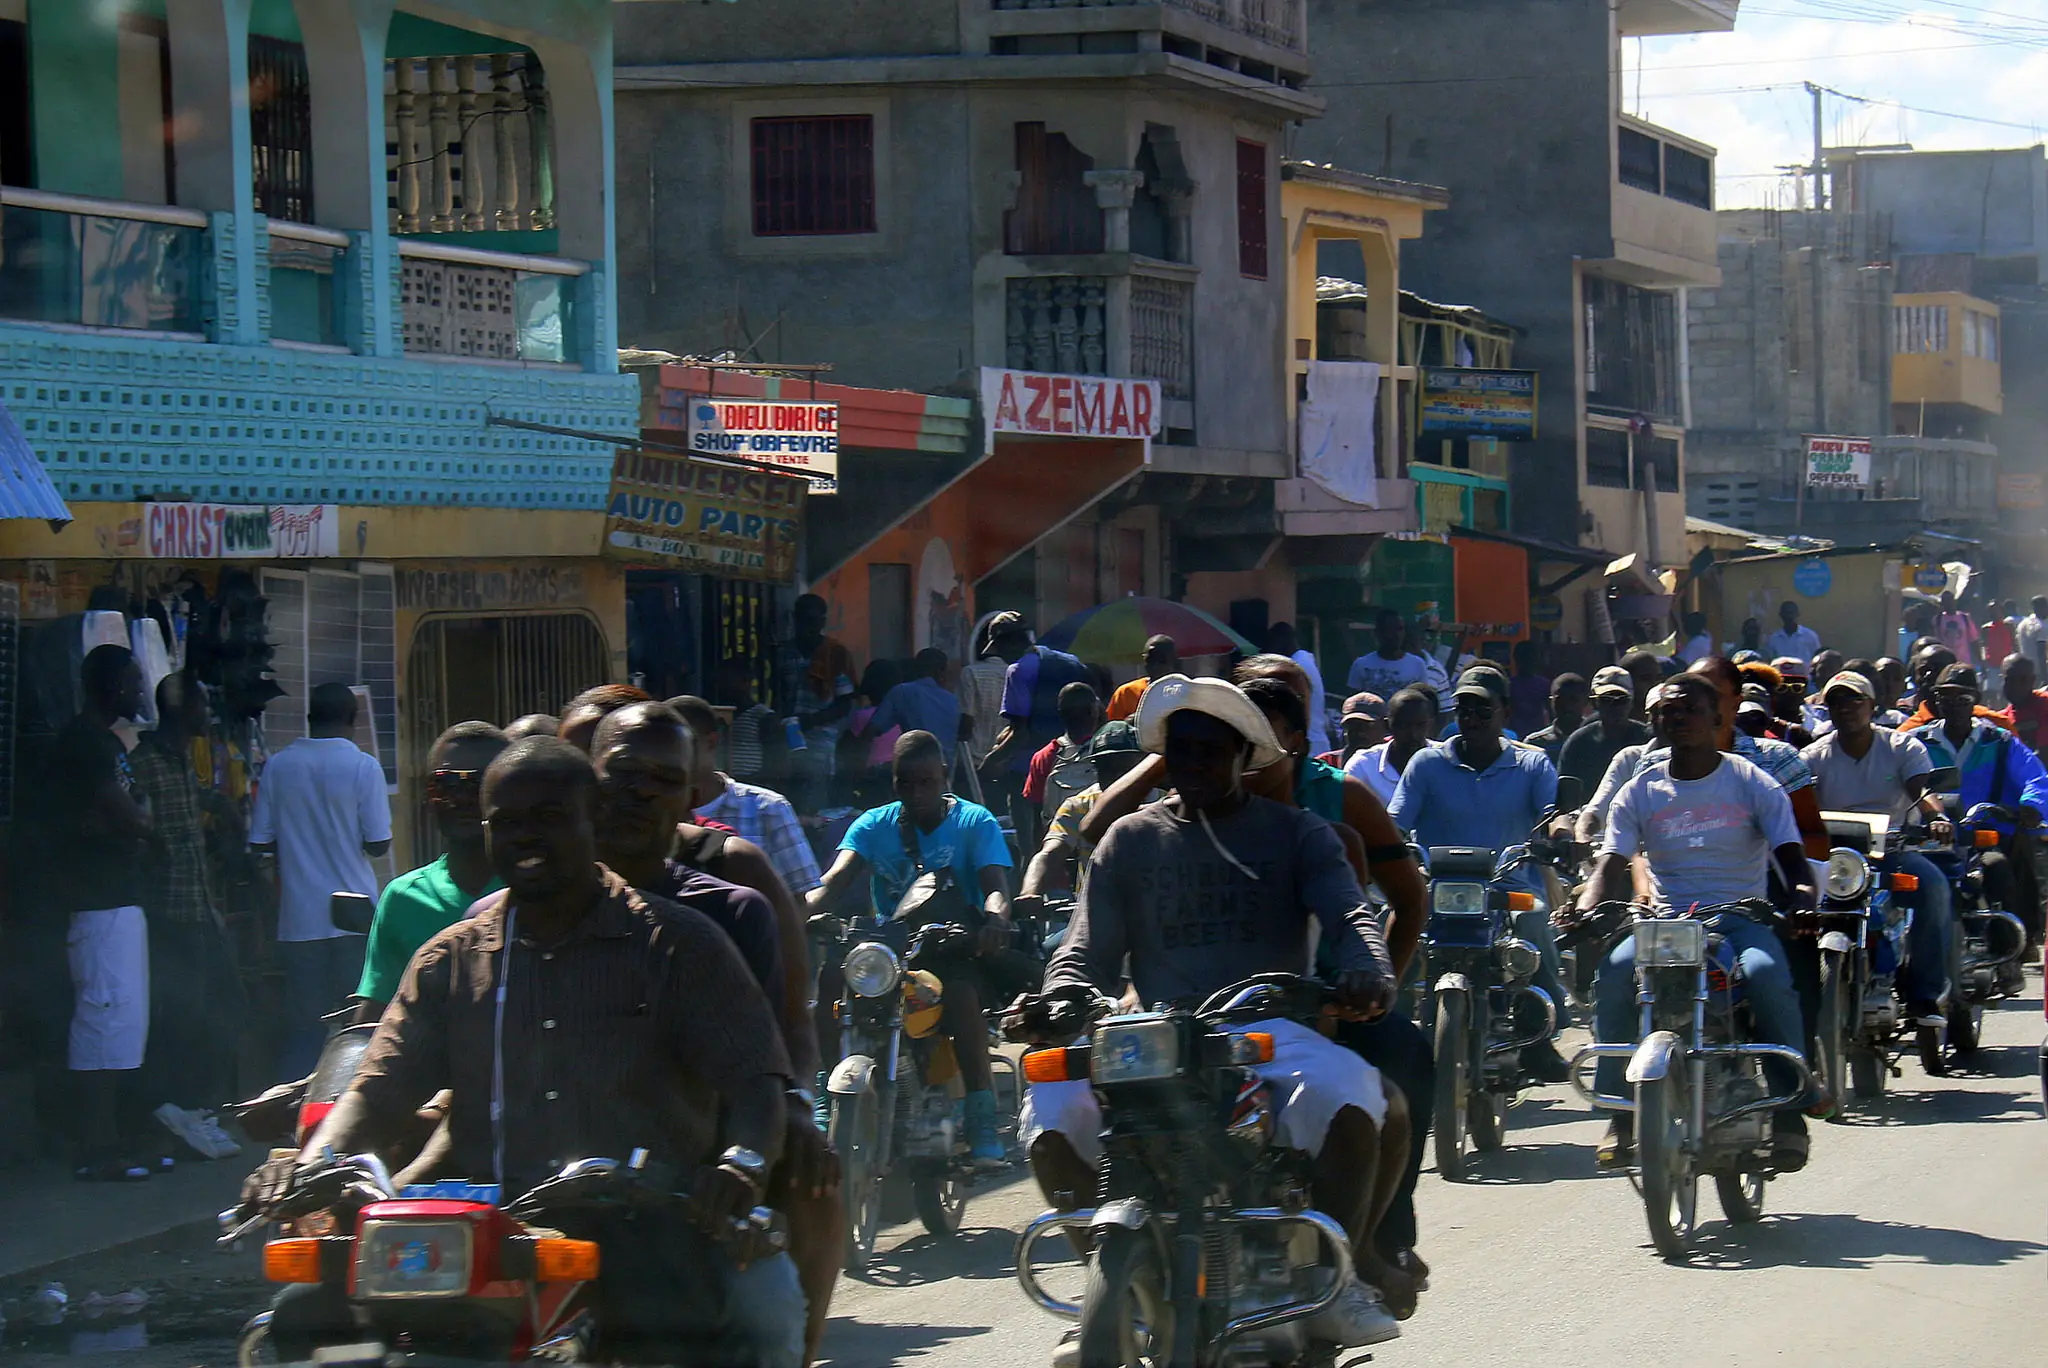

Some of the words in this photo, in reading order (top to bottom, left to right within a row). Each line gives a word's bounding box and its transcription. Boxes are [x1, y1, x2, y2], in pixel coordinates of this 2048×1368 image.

[774, 405, 838, 432] DIRIGE
[994, 373, 1152, 436] AZEMAR
[694, 432, 745, 451] SHOP
[150, 505, 226, 557] CHRIST
[608, 492, 684, 527] AUTO
[700, 506, 799, 545] PARTS
